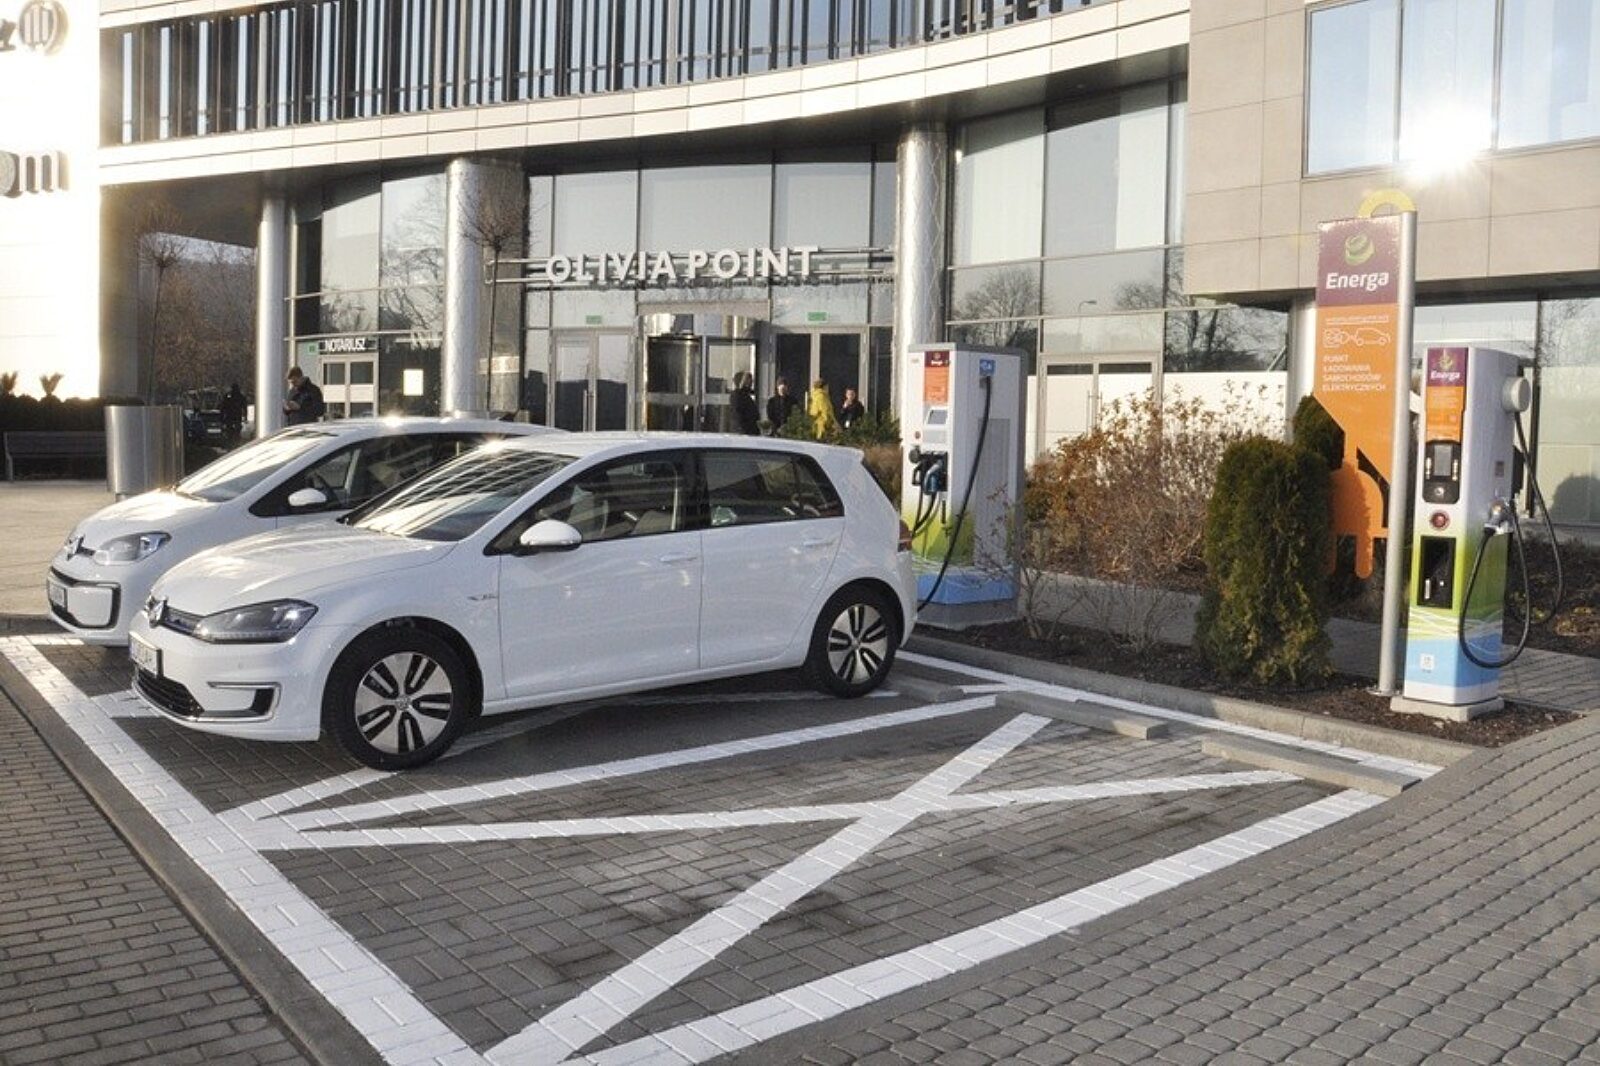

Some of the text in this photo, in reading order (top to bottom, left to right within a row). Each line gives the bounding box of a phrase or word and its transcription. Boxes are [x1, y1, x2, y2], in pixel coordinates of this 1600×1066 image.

[545, 246, 819, 283] OLIVIA POINT
[1325, 272, 1390, 292] Energa
[1323, 354, 1349, 363] PUNKT
[1430, 370, 1461, 382] Energa
